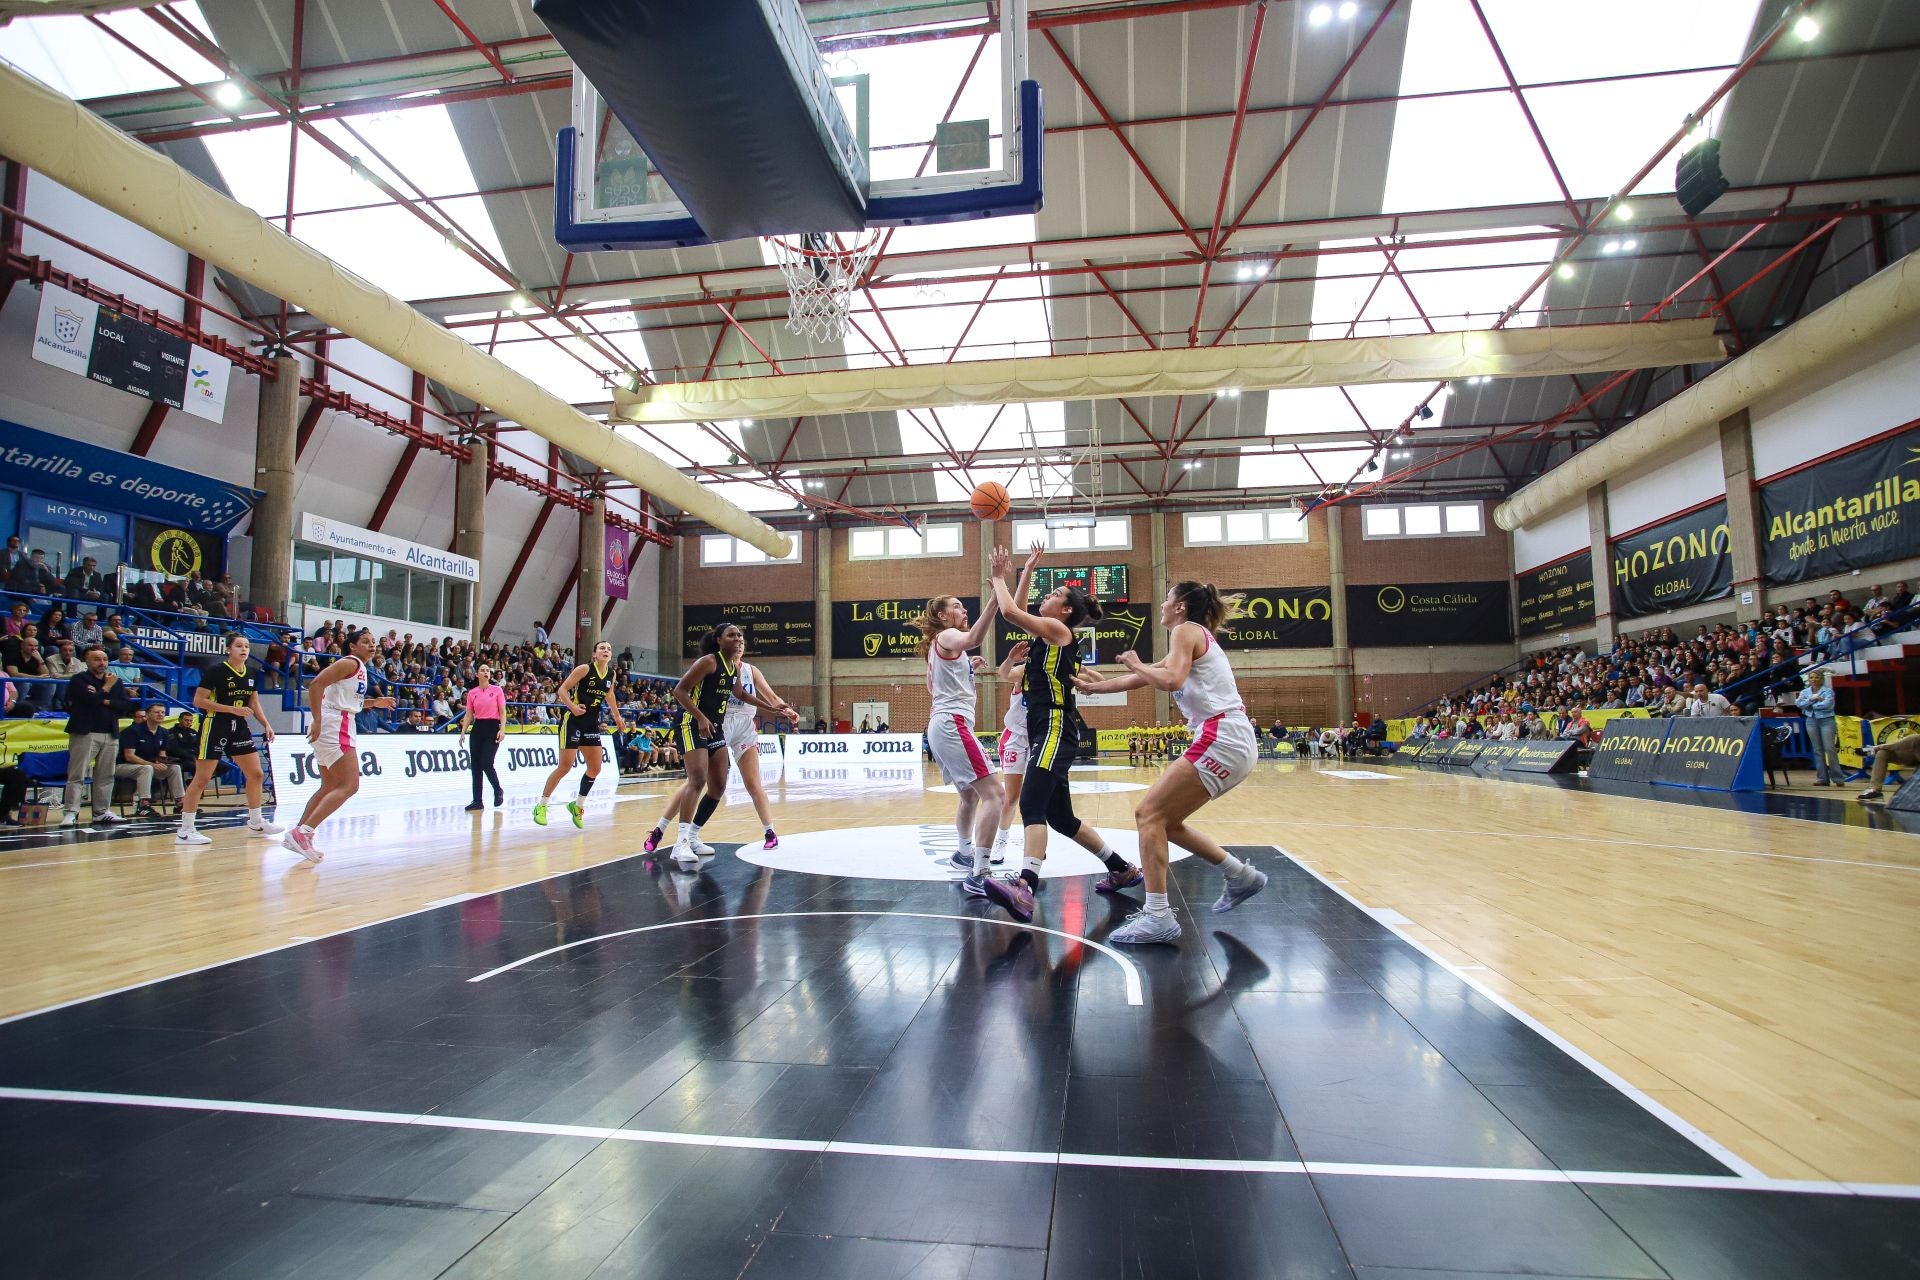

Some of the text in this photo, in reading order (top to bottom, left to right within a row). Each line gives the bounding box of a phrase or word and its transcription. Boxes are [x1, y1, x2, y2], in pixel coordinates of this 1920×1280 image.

[98, 327, 126, 344] LOCAL
[38, 335, 88, 361] Alcantarilla
[161, 351, 185, 367] VISITANTE
[92, 372, 113, 385] FALTAS
[126, 384, 150, 397] JUGADOR
[164, 397, 181, 408] FALTAS
[0, 446, 207, 509] tarilla es deporte
[47, 504, 108, 525] HOZONO
[1768, 474, 1920, 542] Alcantarilla
[1789, 508, 1899, 561] donde la huerta nace
[329, 531, 474, 578] Ayuntamiento de Alcantarilla
[1614, 523, 1731, 586] HOZONO
[1539, 564, 1568, 583] HOZONO
[1654, 577, 1691, 597] GLOBAL
[1411, 593, 1478, 605] Costa Cálida
[723, 605, 771, 615] HOZONO
[852, 601, 928, 621] La Hacie
[887, 632, 920, 645] la boca
[1005, 631, 1036, 640] Alcan
[1228, 630, 1279, 641] GLOBAL
[718, 700, 727, 714] 3
[1101, 733, 1131, 741] HOZO
[1599, 736, 1661, 755] HOZONO
[1662, 736, 1744, 757] HOZONO
